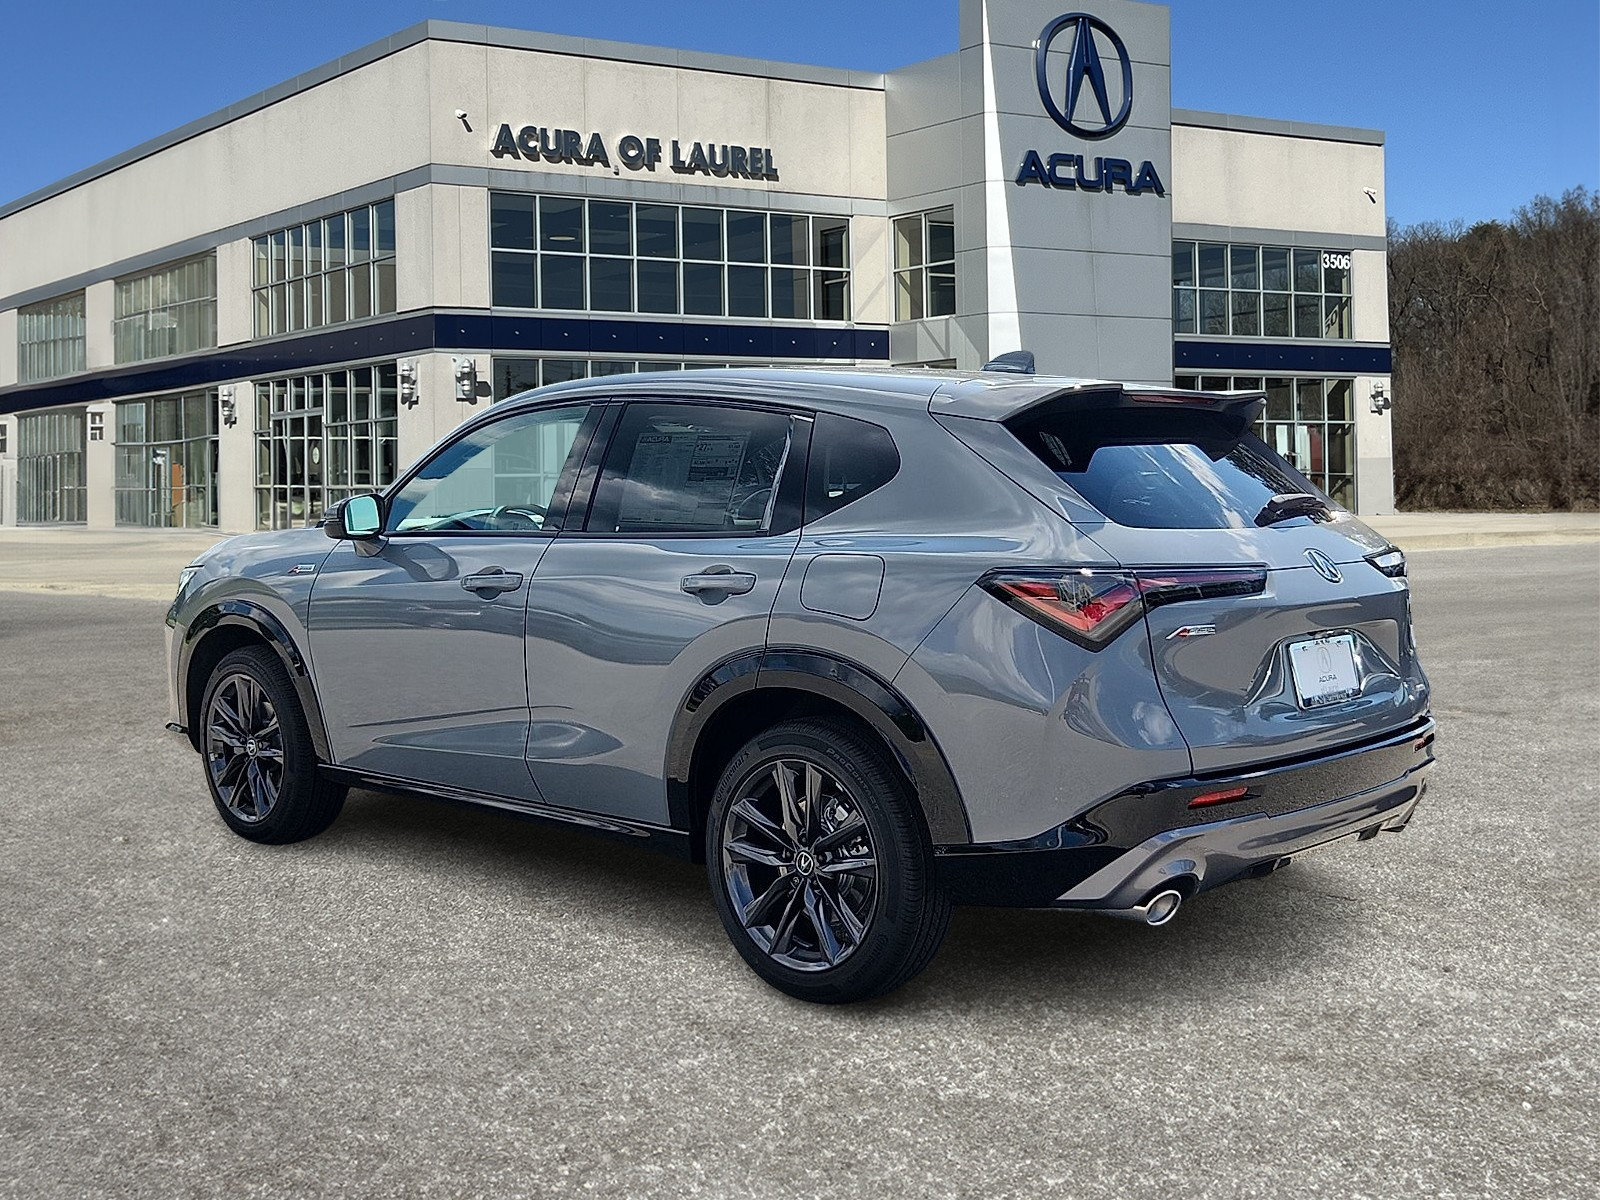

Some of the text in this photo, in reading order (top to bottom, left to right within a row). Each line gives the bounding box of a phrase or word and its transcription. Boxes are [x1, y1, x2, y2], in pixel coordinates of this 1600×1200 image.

[491, 124, 778, 180] ACURA OF LAUREL
[1016, 150, 1165, 197] ACURA
[1322, 253, 1351, 270] 3506
